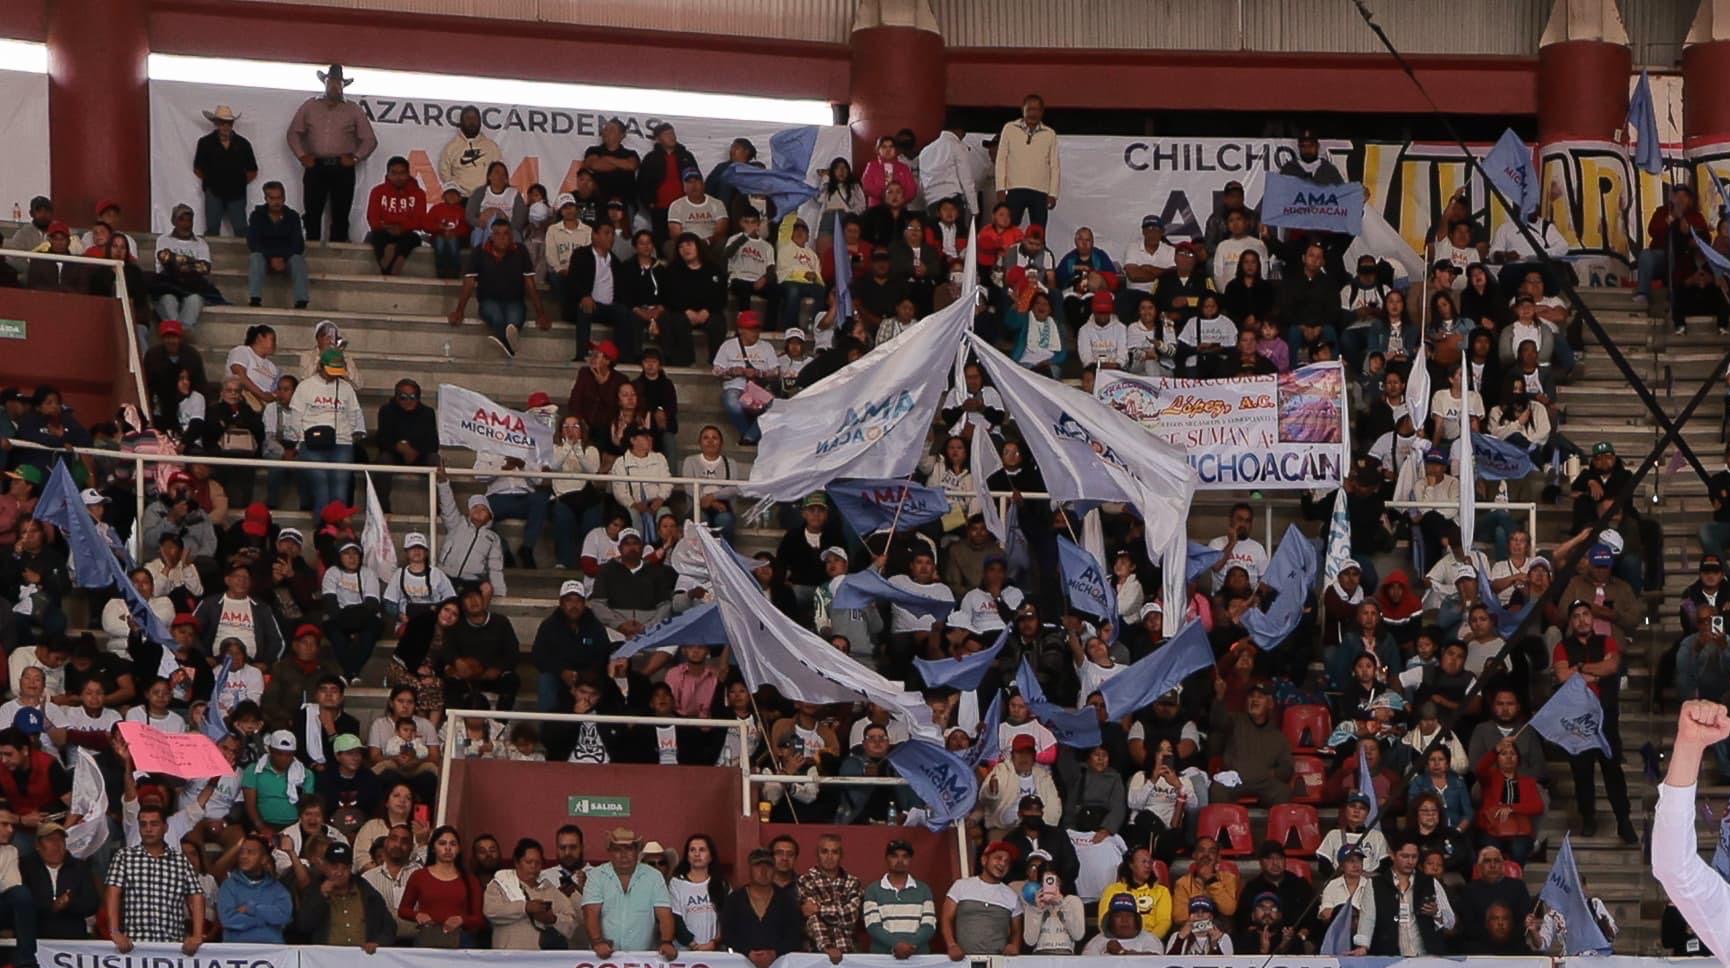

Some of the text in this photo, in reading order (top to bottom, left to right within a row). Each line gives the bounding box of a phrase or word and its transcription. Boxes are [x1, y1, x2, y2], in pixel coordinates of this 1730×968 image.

[358, 97, 466, 129] ÁZARO
[1124, 142, 1296, 171] CHILCHO
[1294, 191, 1339, 206] AMA
[688, 212, 713, 220] AMA
[742, 247, 762, 257] AMA
[314, 396, 343, 405] AMA
[473, 407, 528, 434] AMA
[1187, 427, 1250, 449] SUMAN
[1475, 444, 1508, 463] MA
[1187, 446, 1341, 482] ICHOACÁN
[1227, 554, 1253, 563] AMA
[1067, 579, 1106, 606] MICHO
[222, 612, 252, 623] AMA
[919, 764, 955, 811] MICHOA
[934, 763, 968, 803] AM
[591, 802, 623, 811] SALIDA
[687, 894, 711, 905] AM
